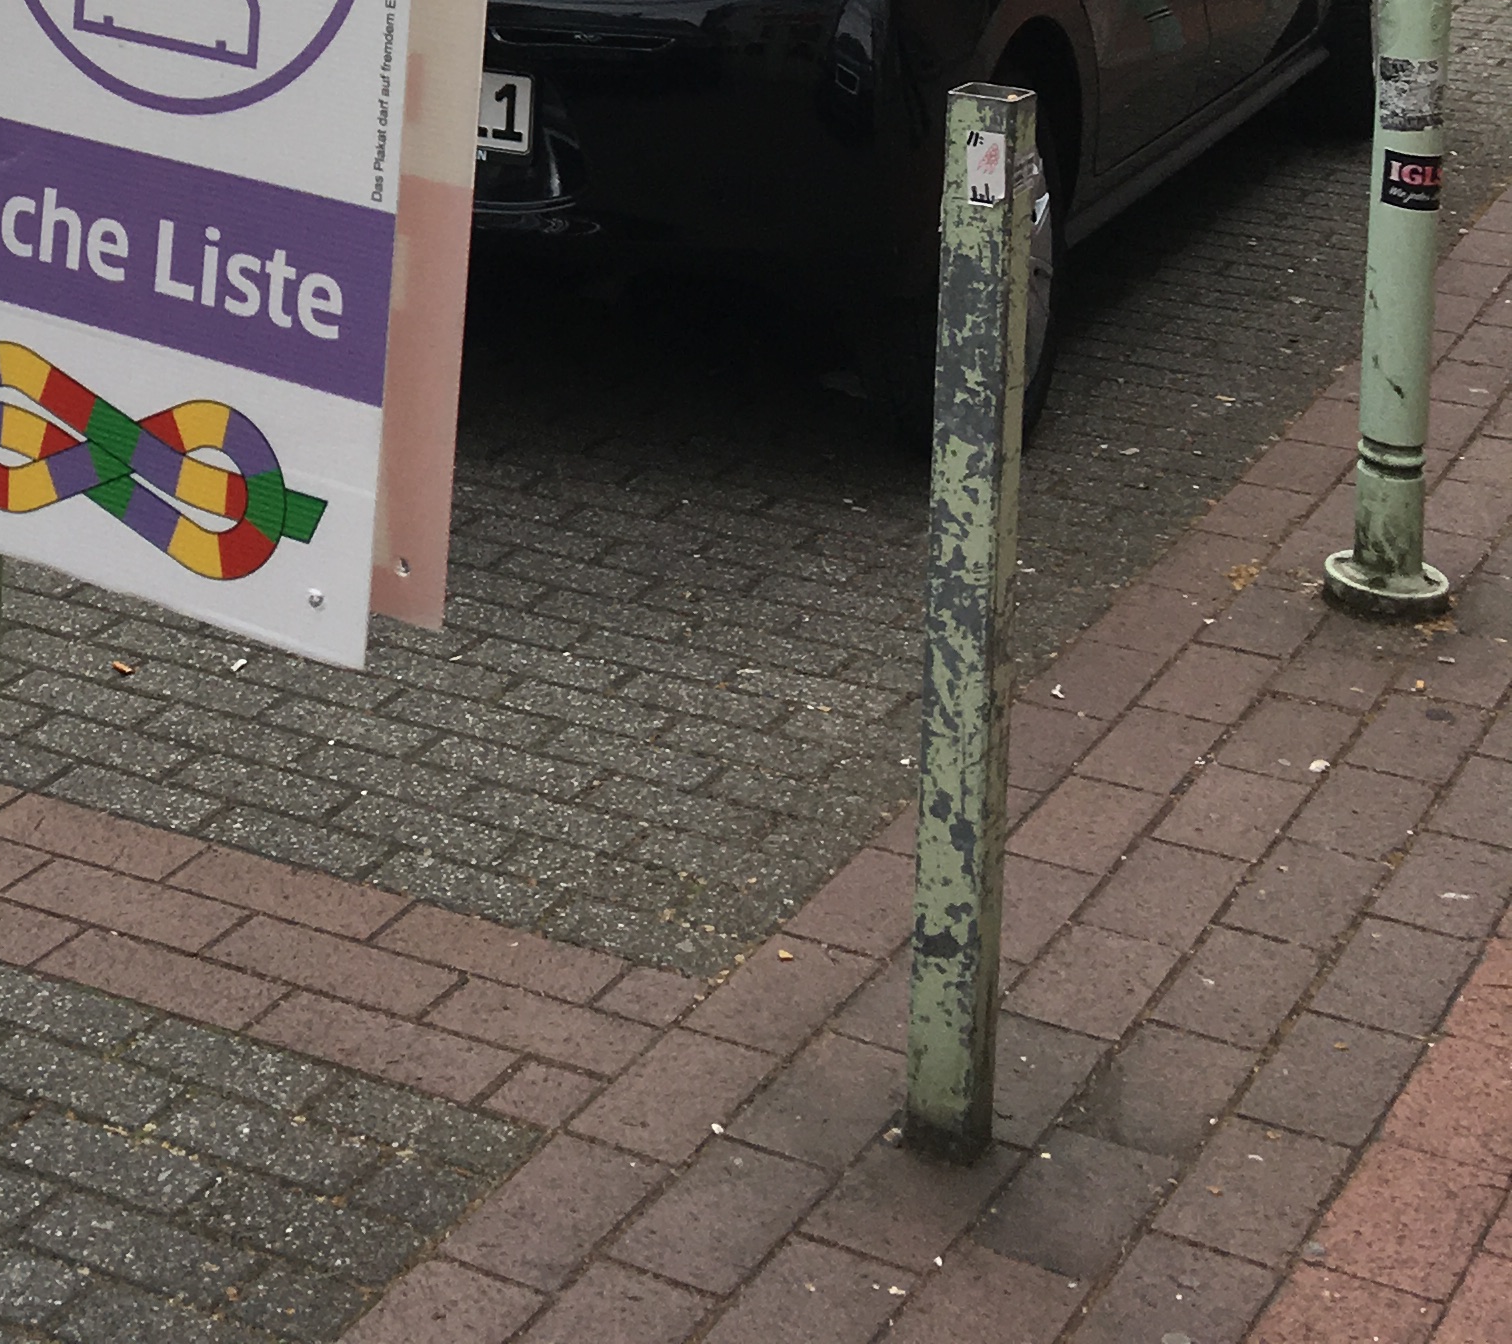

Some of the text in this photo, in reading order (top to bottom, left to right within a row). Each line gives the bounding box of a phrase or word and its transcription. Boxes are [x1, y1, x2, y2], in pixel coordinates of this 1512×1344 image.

[380, 13, 395, 71] fremdem
[378, 72, 390, 97] auf
[376, 99, 389, 127] darf
[373, 129, 387, 171] Plakat
[370, 175, 384, 202] Das
[154, 219, 345, 341] Liste
